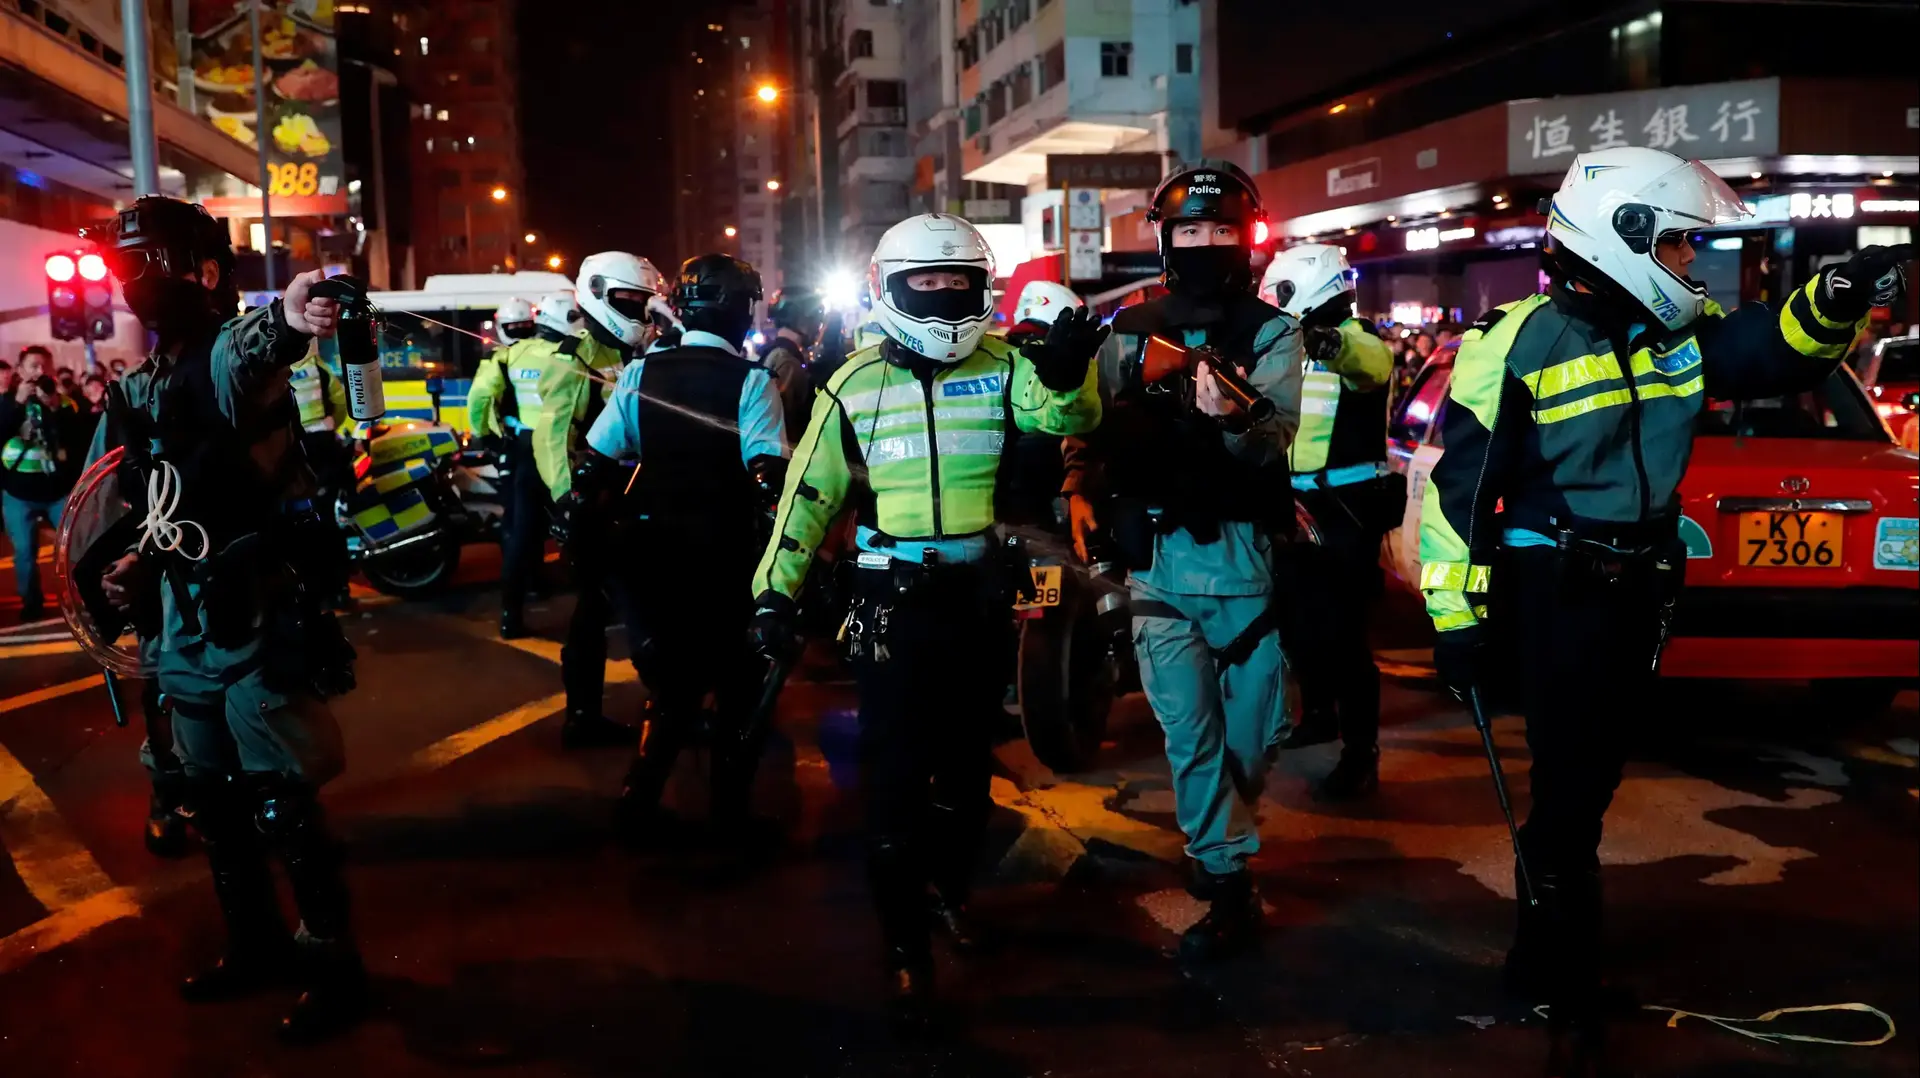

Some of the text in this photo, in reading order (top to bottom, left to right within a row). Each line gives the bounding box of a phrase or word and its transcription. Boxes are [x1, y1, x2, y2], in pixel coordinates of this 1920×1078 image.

[1525, 99, 1762, 159] 恒生銀行
[1188, 185, 1222, 196] Police
[906, 335, 925, 354] FEG
[353, 369, 366, 406] POLICE
[1769, 513, 1813, 540] KY
[1747, 540, 1834, 566] 7306
